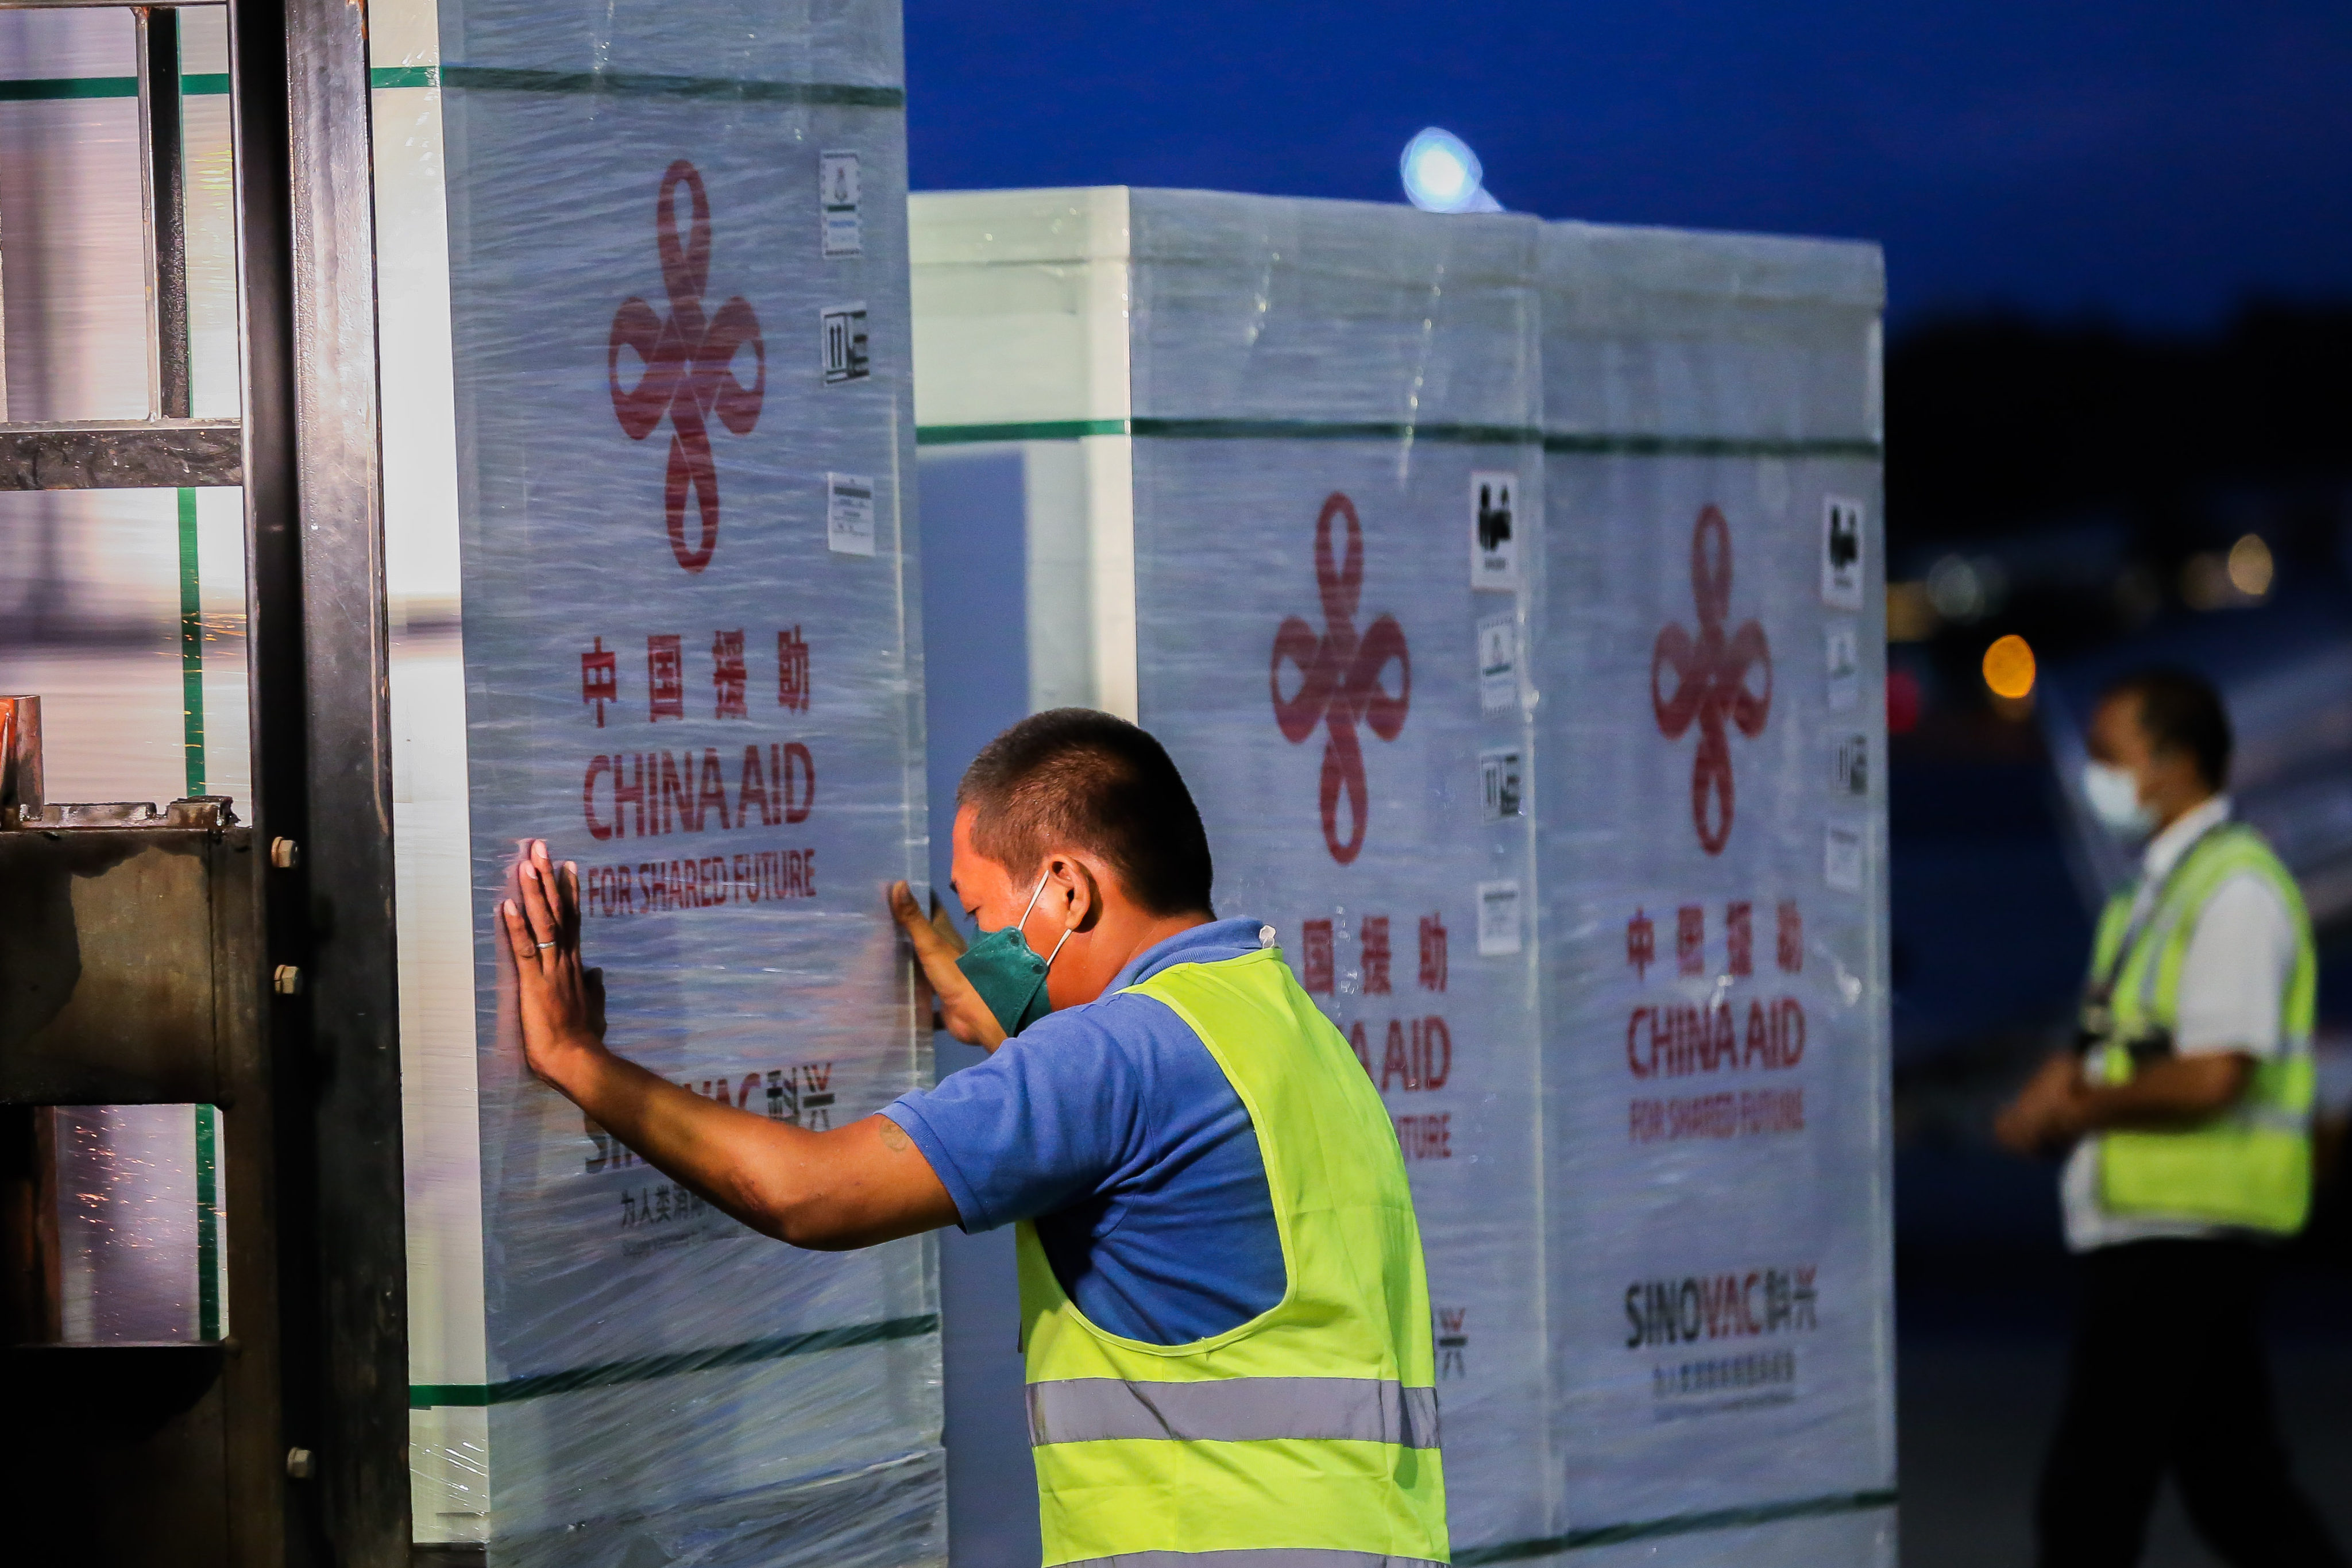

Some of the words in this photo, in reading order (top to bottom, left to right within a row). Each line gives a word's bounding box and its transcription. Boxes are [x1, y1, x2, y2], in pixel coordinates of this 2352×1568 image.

[581, 624, 810, 728] 中国援助
[583, 748, 730, 840] CHINA
[738, 742, 816, 827] AID
[588, 865, 633, 917] FOR
[638, 856, 728, 915] SHARED
[733, 848, 817, 904] FUTURE
[1382, 1016, 1452, 1092] AID
[1627, 1000, 1738, 1079] CHINA
[1744, 996, 1806, 1070] AID
